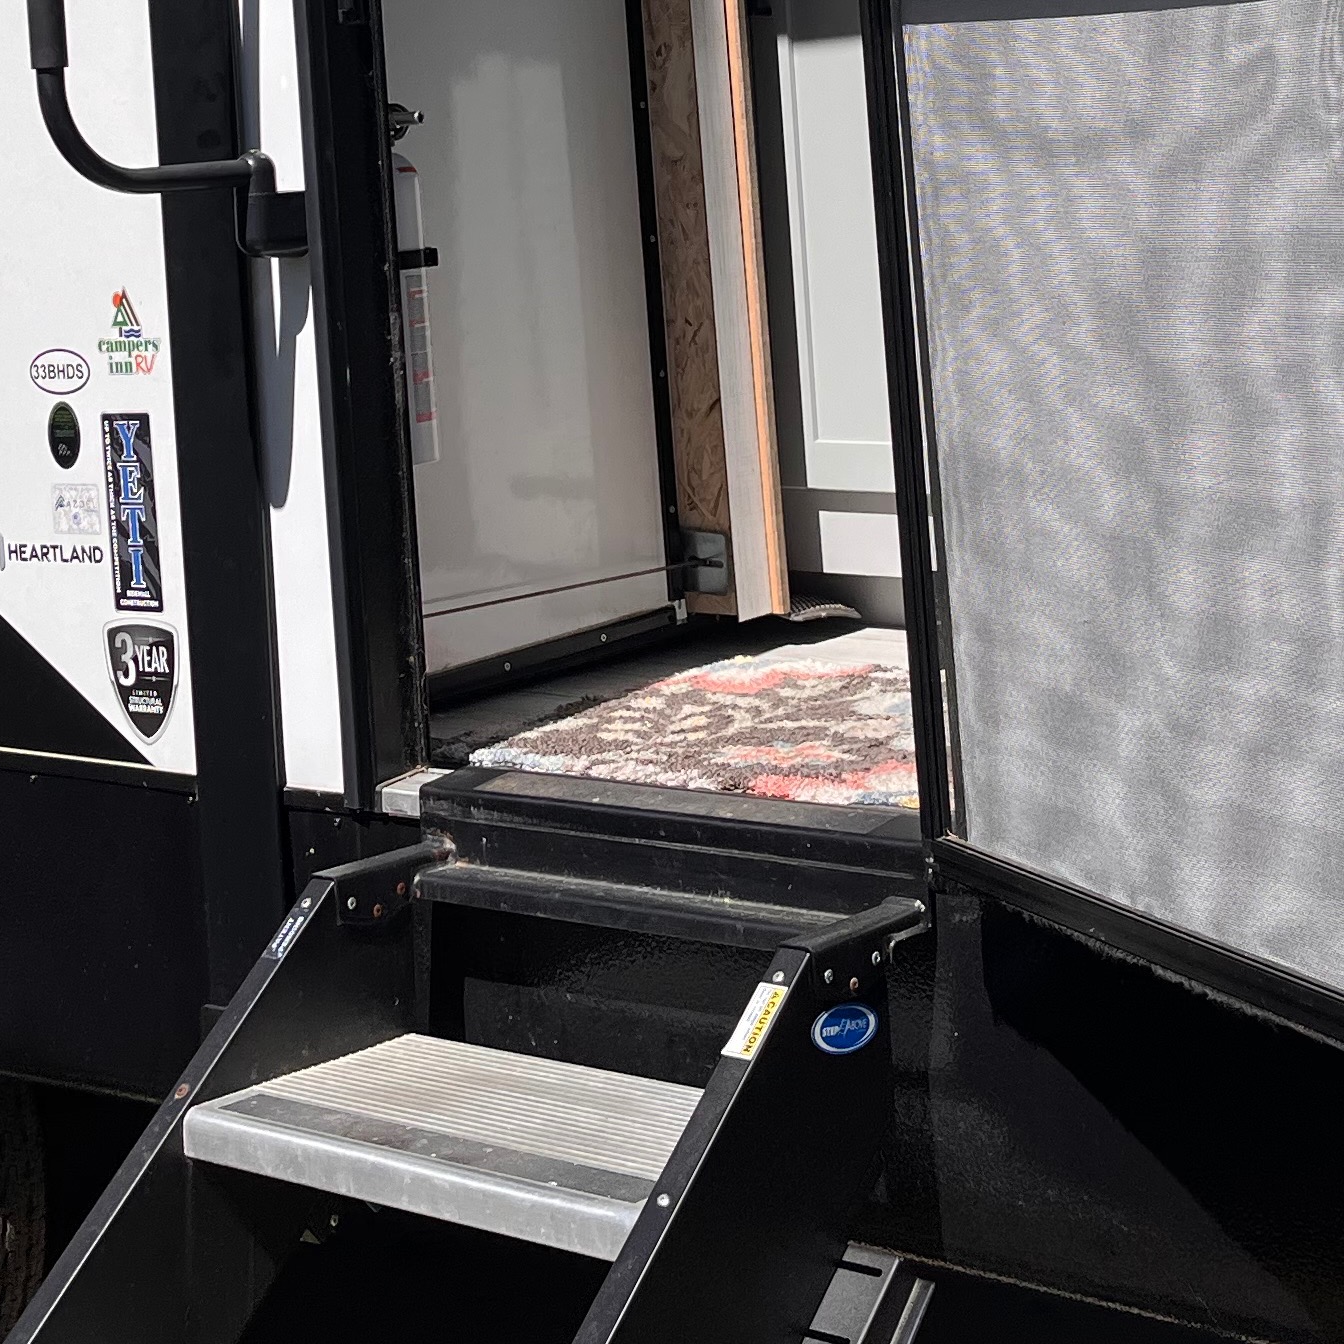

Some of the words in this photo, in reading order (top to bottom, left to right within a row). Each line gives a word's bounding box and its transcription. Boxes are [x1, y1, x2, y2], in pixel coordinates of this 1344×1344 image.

[97, 339, 159, 358] campers
[33, 363, 84, 380] 33BHDS
[109, 355, 133, 374] inn
[134, 353, 156, 375] RV
[113, 420, 147, 588] YETI
[7, 542, 104, 564] HEARTLAND
[114, 631, 136, 687] 3
[134, 644, 169, 673] YEAR
[743, 1001, 776, 1053] CAUTION
